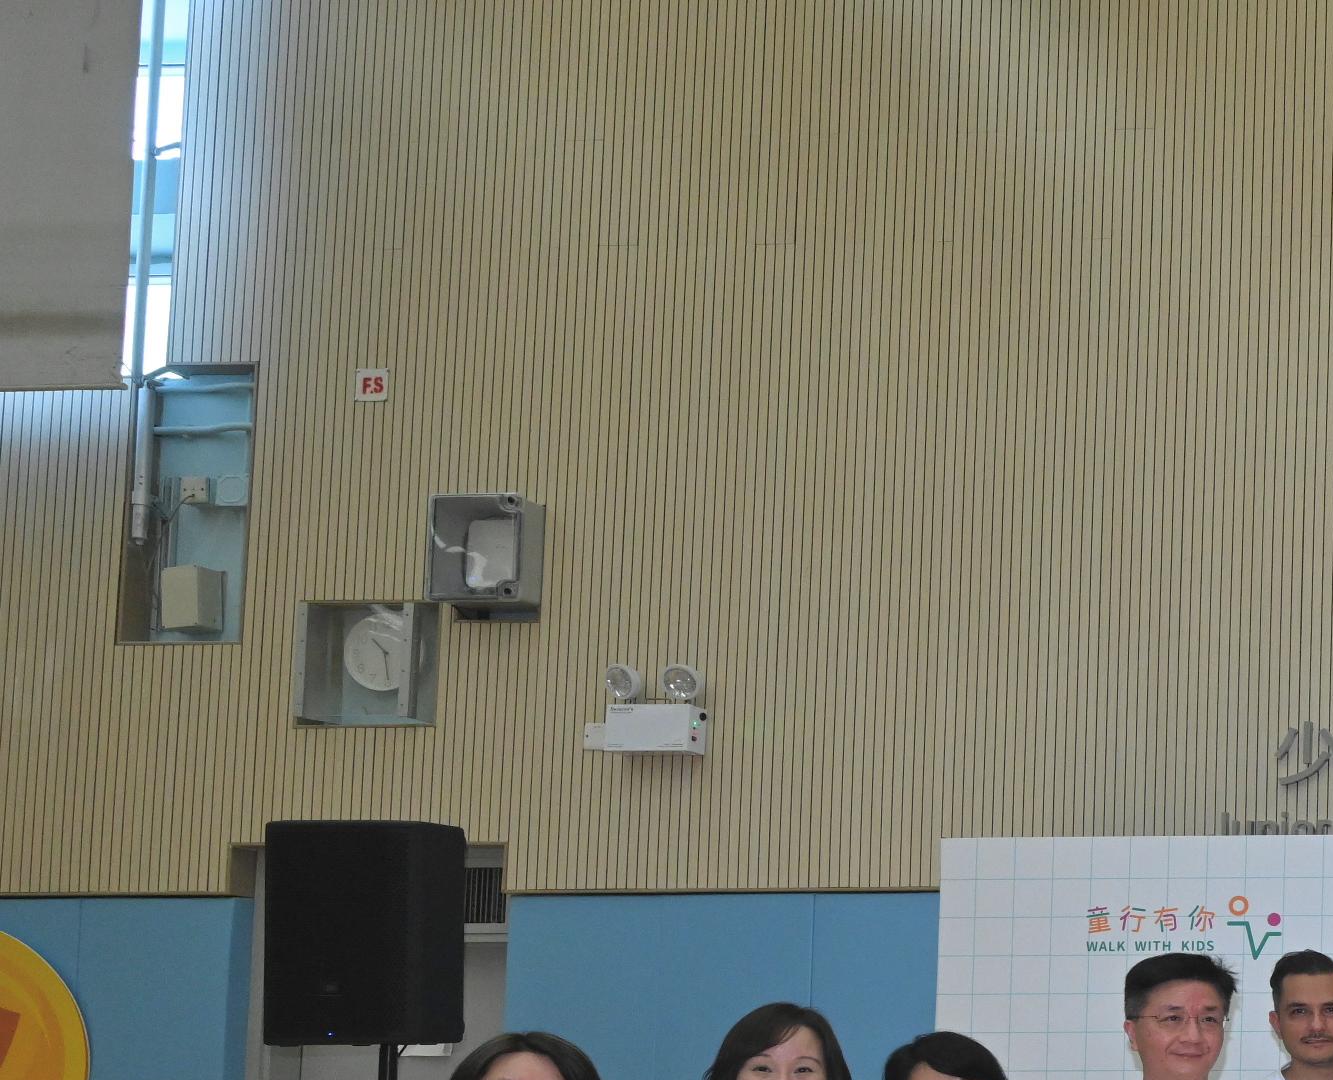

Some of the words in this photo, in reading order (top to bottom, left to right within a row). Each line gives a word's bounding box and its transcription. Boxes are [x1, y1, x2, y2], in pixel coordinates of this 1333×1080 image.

[1086, 904, 1216, 934] 童行有你
[1086, 940, 1126, 952] WALK
[1135, 940, 1171, 952] WITH
[1181, 940, 1216, 952] KIDS
